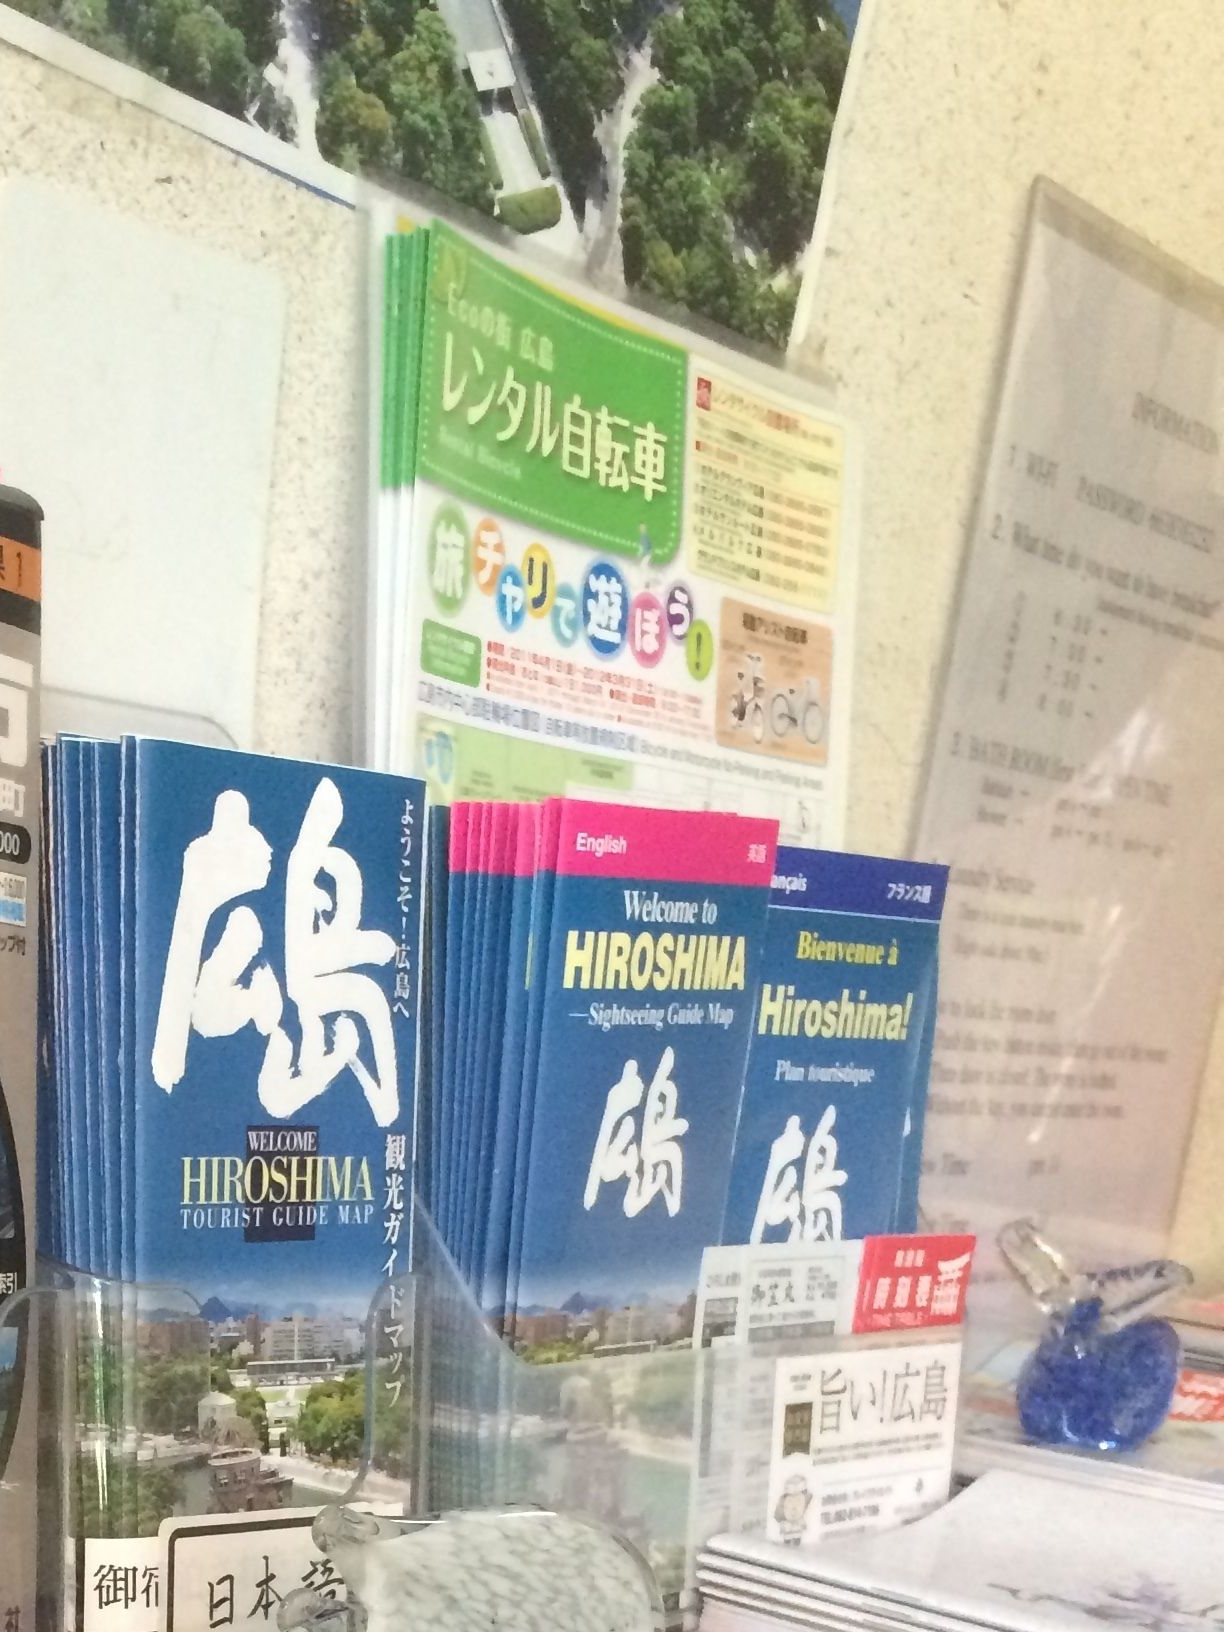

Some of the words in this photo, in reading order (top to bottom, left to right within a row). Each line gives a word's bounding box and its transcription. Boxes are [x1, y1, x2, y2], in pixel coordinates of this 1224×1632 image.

[442, 331, 668, 502] レンタル自転車
[576, 832, 628, 857] English
[623, 890, 698, 923] Welcome
[702, 899, 717, 924] to
[562, 930, 746, 991] HIROSHIMA
[796, 931, 885, 966] Bienvenue
[887, 938, 899, 966] à
[587, 1003, 665, 1032] Sightseeing
[667, 1005, 704, 1028] Guide
[705, 1005, 734, 1030] Map
[757, 984, 914, 1040] Hiroshima!
[775, 1060, 806, 1082] Plan
[247, 1130, 317, 1152] WELCOME
[180, 1155, 376, 1206] HIROSHIMA
[180, 1207, 264, 1230] TOURIST
[272, 1206, 329, 1228] GUIDE
[337, 1205, 375, 1226] MAP
[381, 1134, 407, 1408] 観光ガイドマップ
